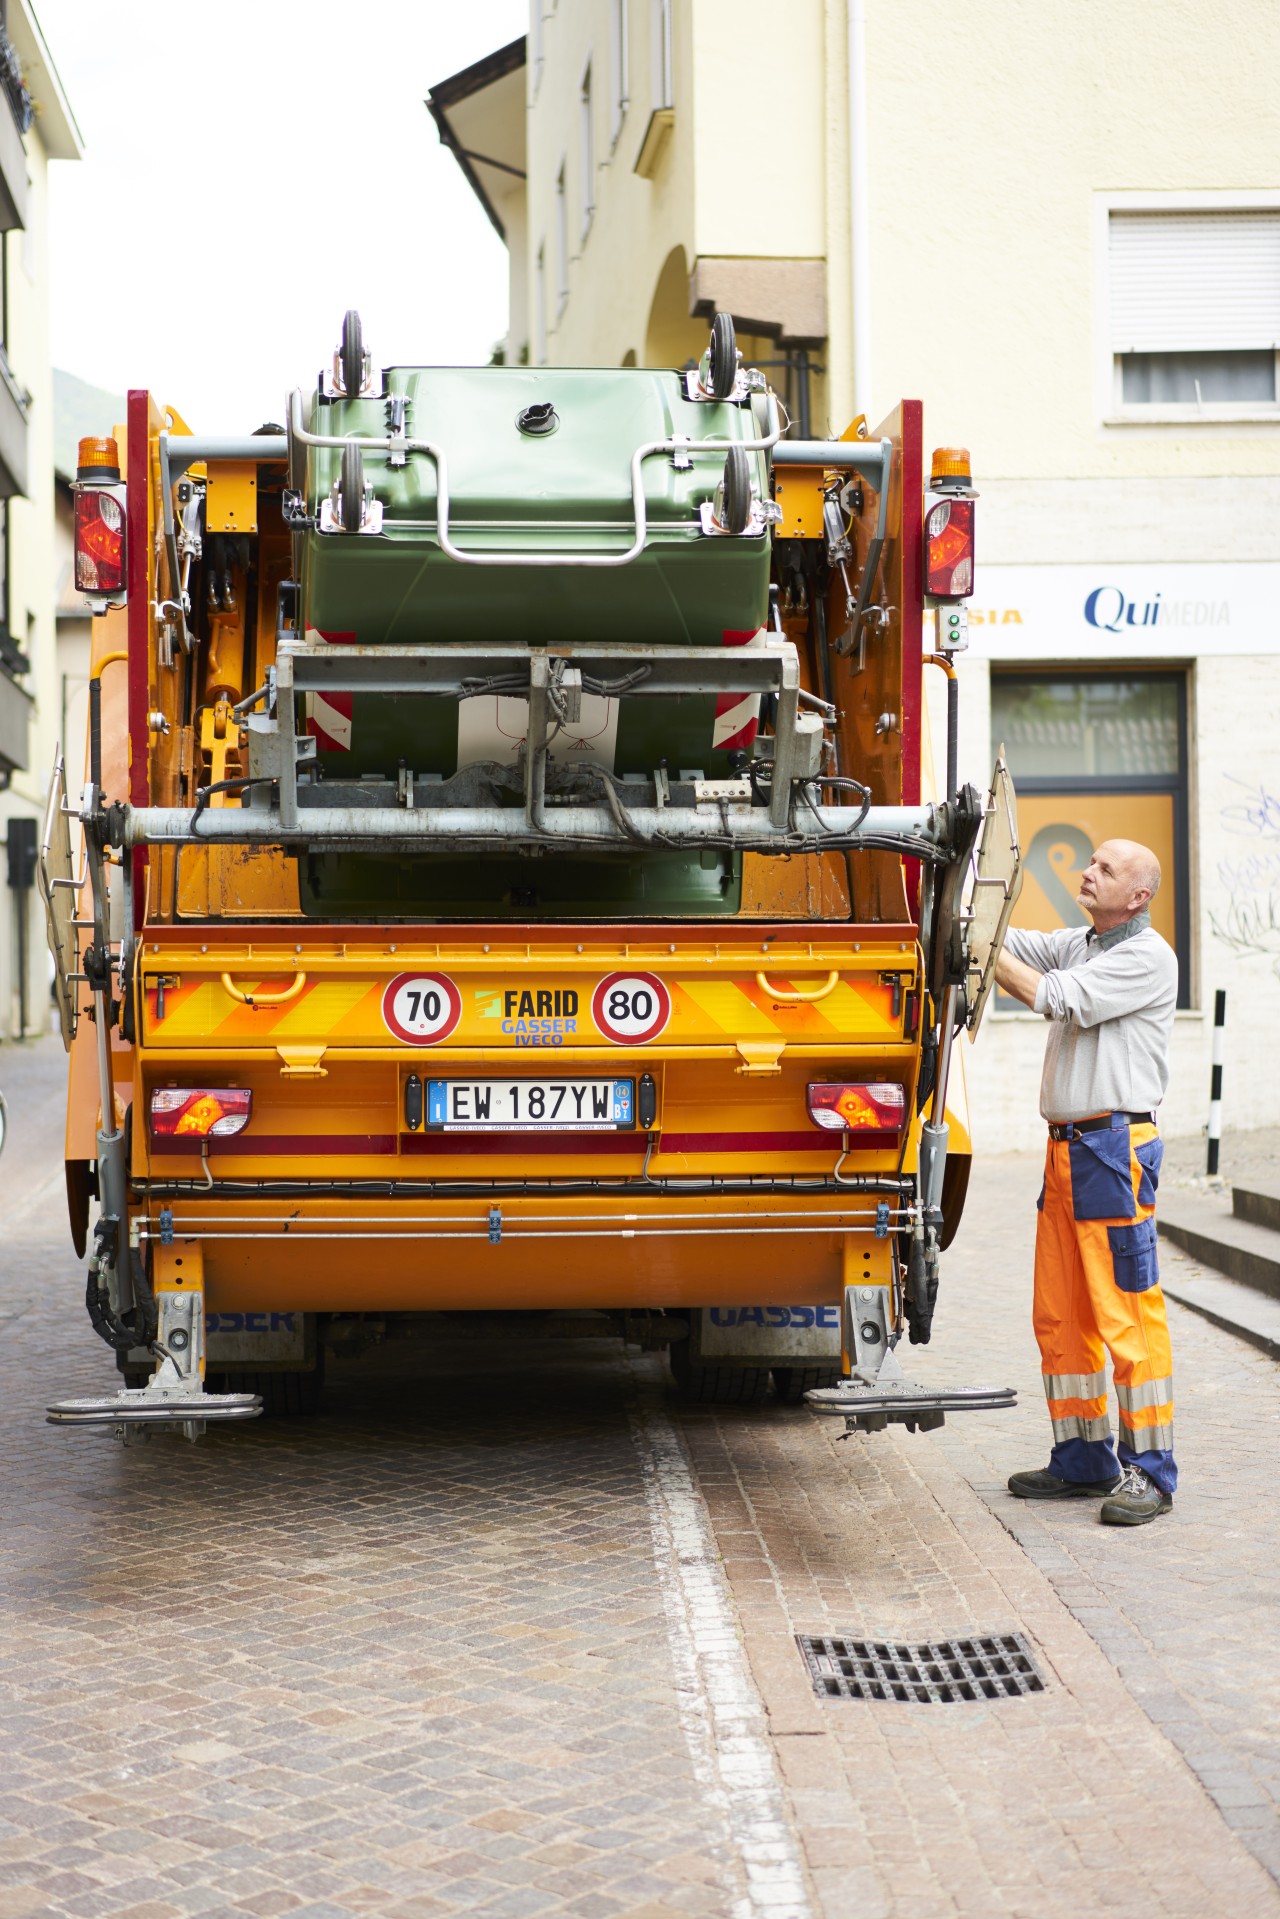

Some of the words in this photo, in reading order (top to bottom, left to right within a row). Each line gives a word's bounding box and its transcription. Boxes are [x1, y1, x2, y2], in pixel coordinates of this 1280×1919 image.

[407, 991, 441, 1021] 70
[504, 990, 579, 1017] FARID
[608, 990, 653, 1020] 80
[501, 1019, 577, 1034] GASSER
[515, 1034, 563, 1046] IVECO
[452, 1086, 492, 1119] EW
[509, 1086, 609, 1119] 187YW
